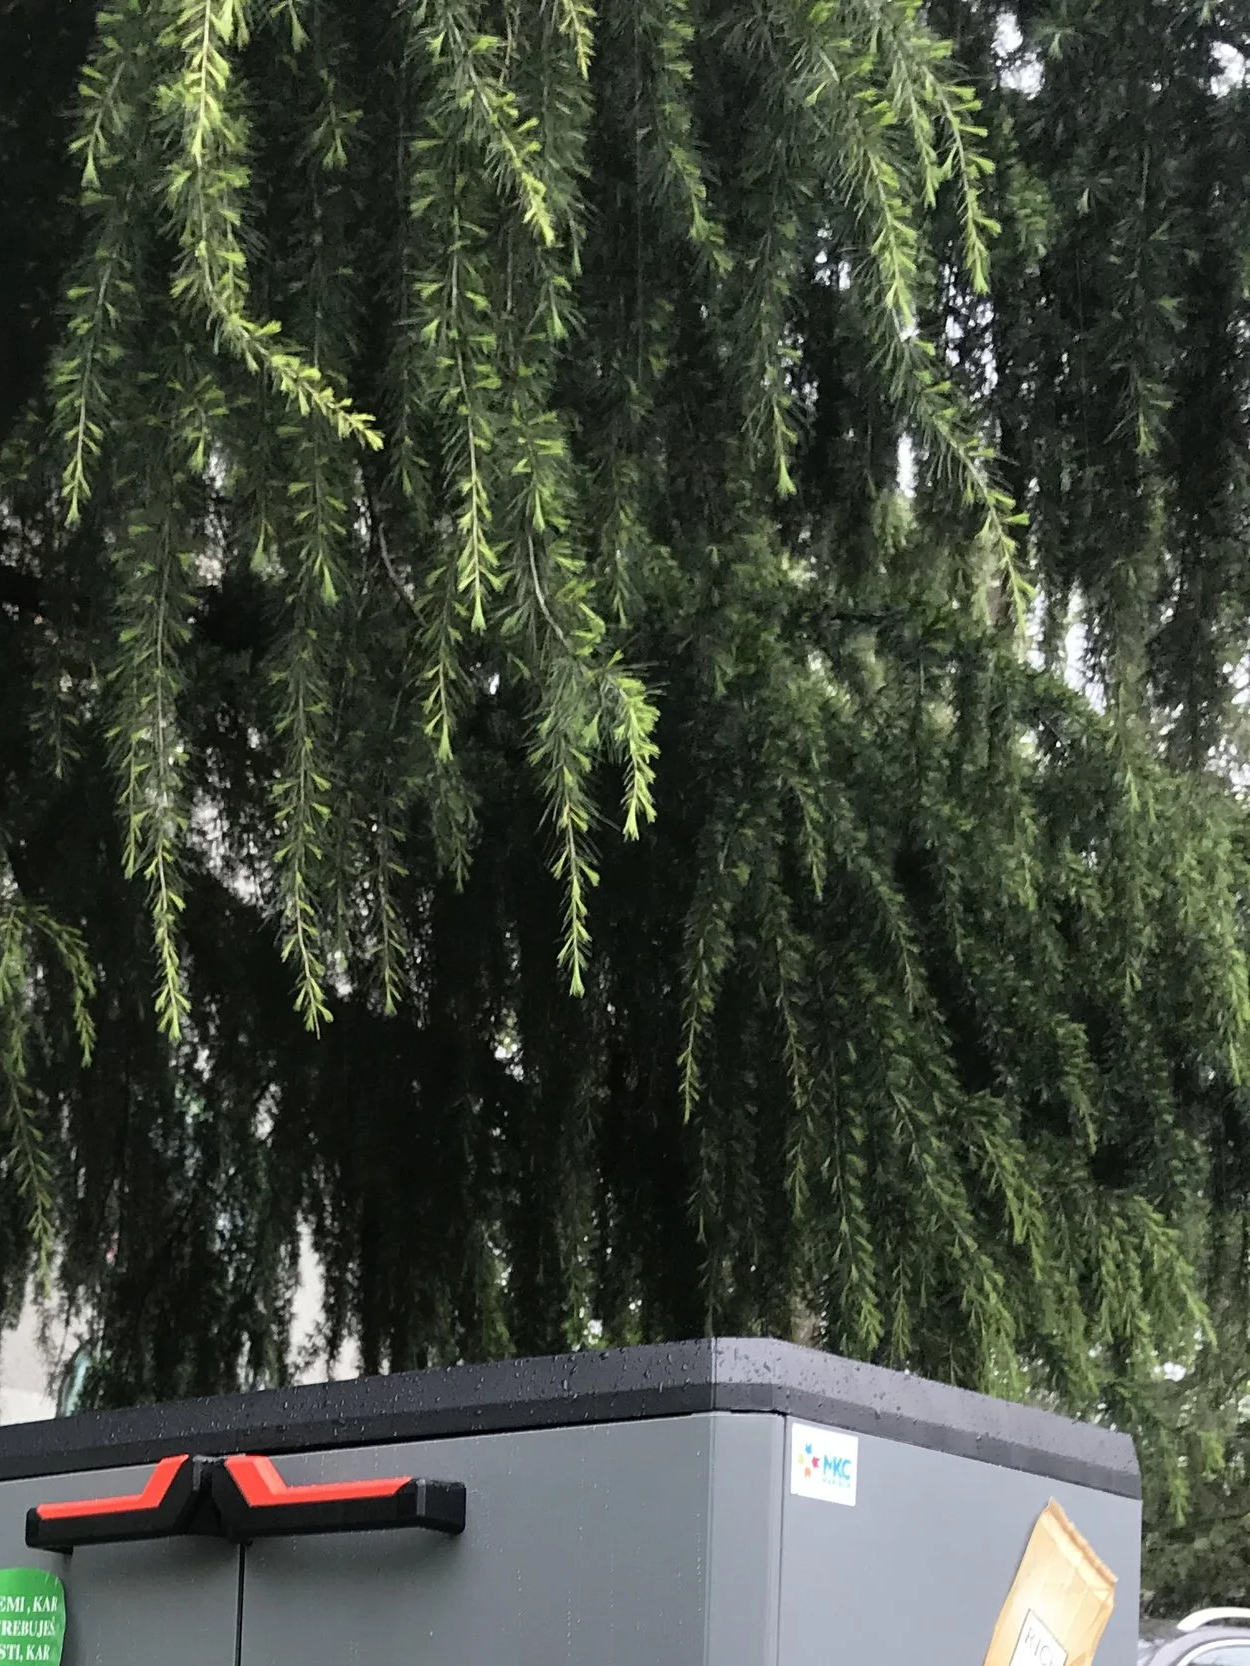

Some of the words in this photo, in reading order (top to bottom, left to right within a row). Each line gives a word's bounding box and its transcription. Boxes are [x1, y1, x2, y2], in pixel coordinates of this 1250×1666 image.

[823, 1454, 852, 1481] MKC
[33, 1595, 58, 1613] KAR
[26, 1644, 51, 1661] KAR
